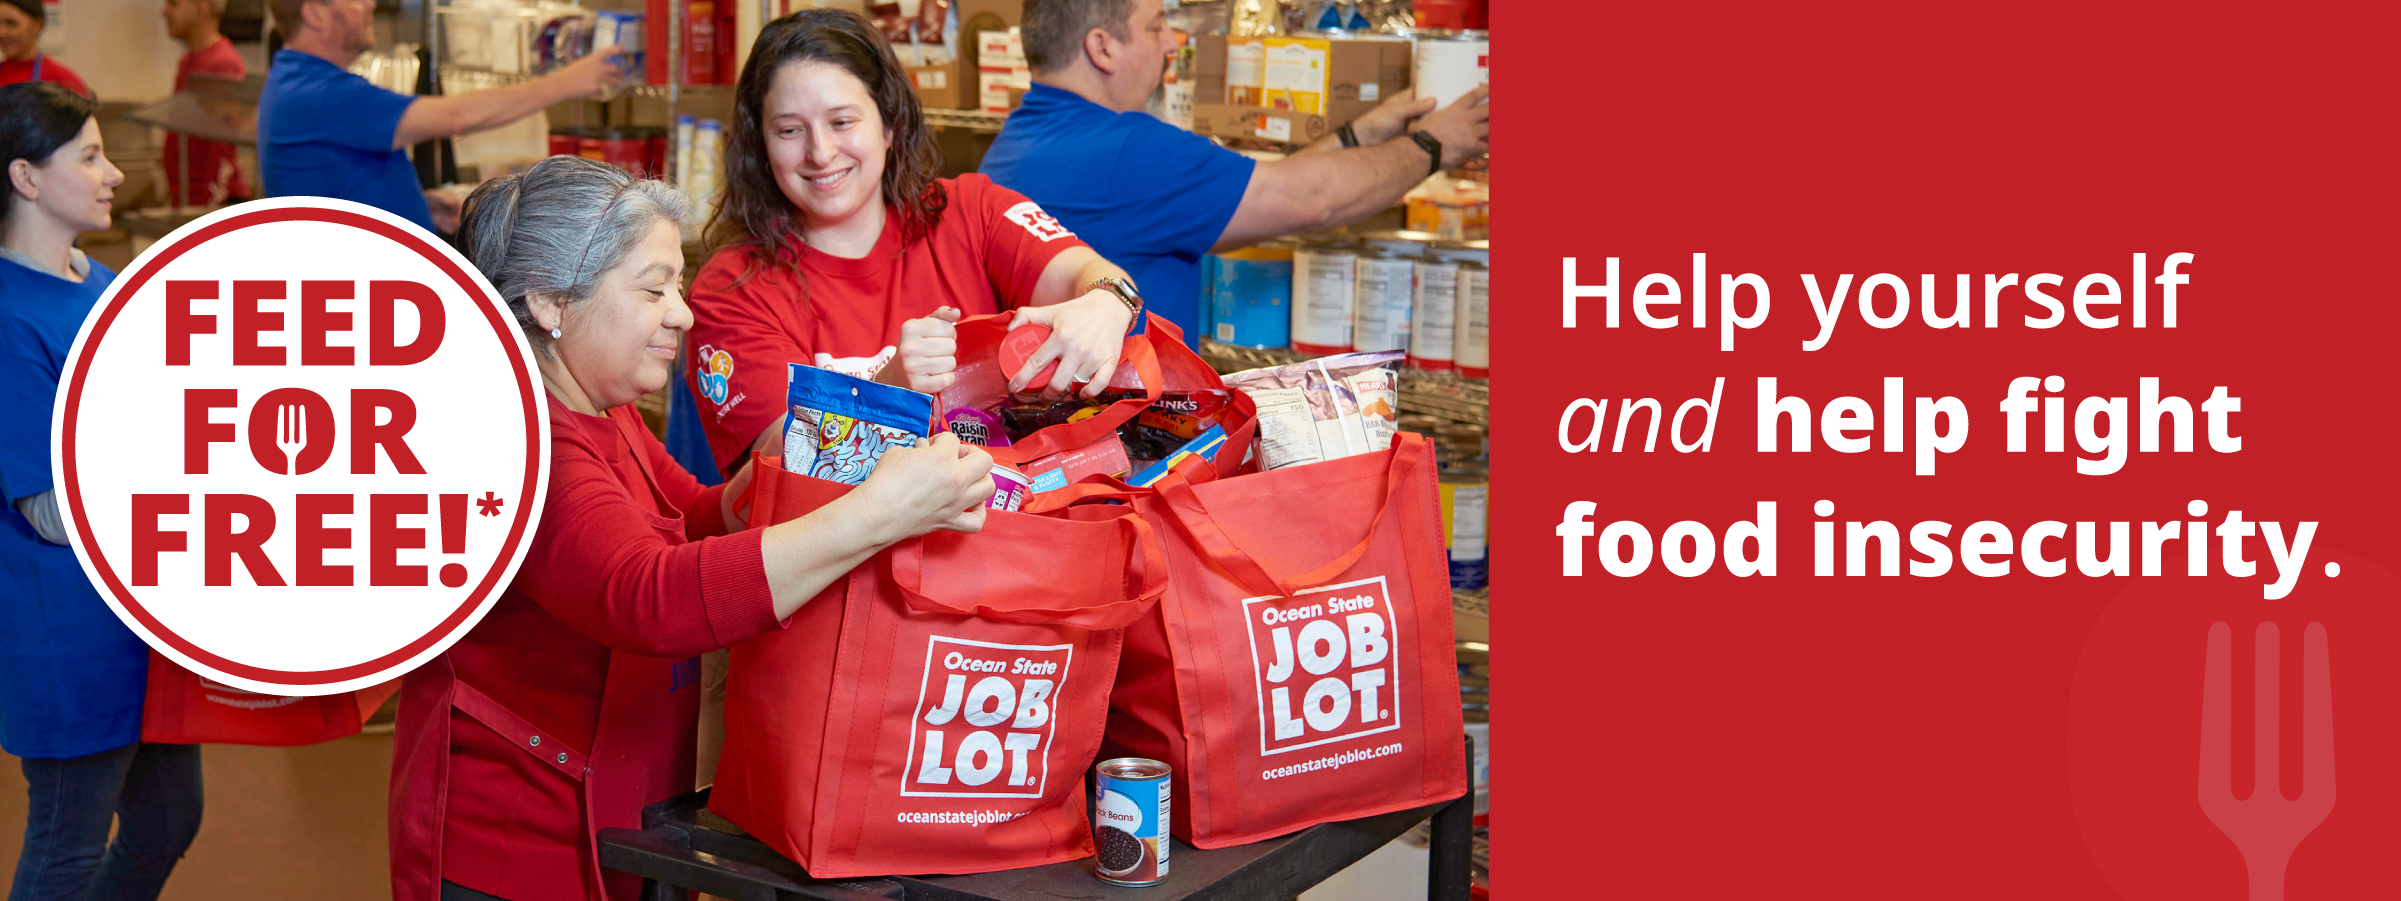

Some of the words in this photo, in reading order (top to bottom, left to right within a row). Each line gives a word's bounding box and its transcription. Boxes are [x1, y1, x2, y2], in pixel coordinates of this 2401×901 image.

[950, 420, 989, 440] Raisin
[1262, 604, 1323, 625] Ocean
[1327, 595, 1375, 615] State
[1266, 612, 1389, 683] JOB
[944, 652, 1006, 673] Ocean
[1011, 657, 1058, 675] State
[924, 674, 1054, 729] JOB
[1262, 743, 1403, 781] oceanstatejoblot.com
[1108, 810, 1135, 822] Beans
